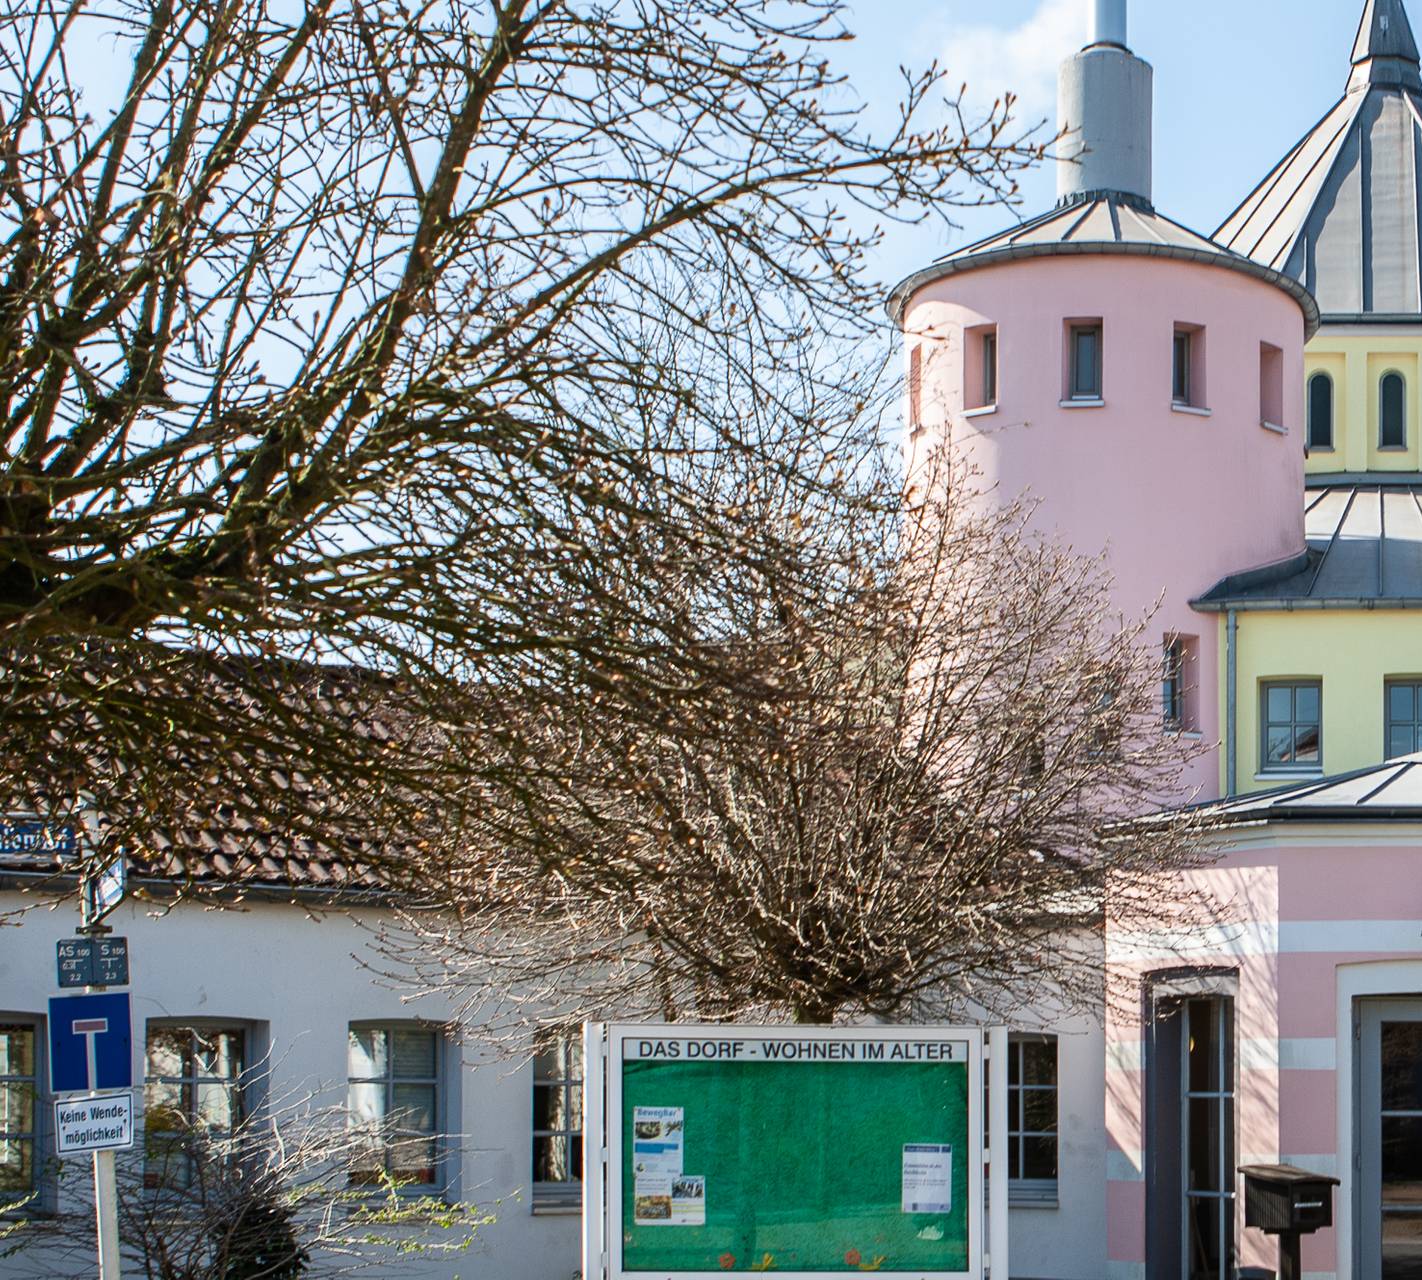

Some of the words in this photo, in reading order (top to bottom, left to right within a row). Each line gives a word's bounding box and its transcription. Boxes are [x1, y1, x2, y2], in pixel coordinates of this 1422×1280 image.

[59, 945, 75, 957] AS
[100, 944, 110, 956] S
[639, 1040, 681, 1058] DAS
[687, 1041, 744, 1058] DORF
[762, 1041, 855, 1059] WOHNEN
[863, 1042, 885, 1059] IM
[890, 1042, 953, 1060] ALTER
[60, 1109, 87, 1124] Keine
[90, 1105, 128, 1121] Wende-
[65, 1126, 123, 1145] möglichkeit
